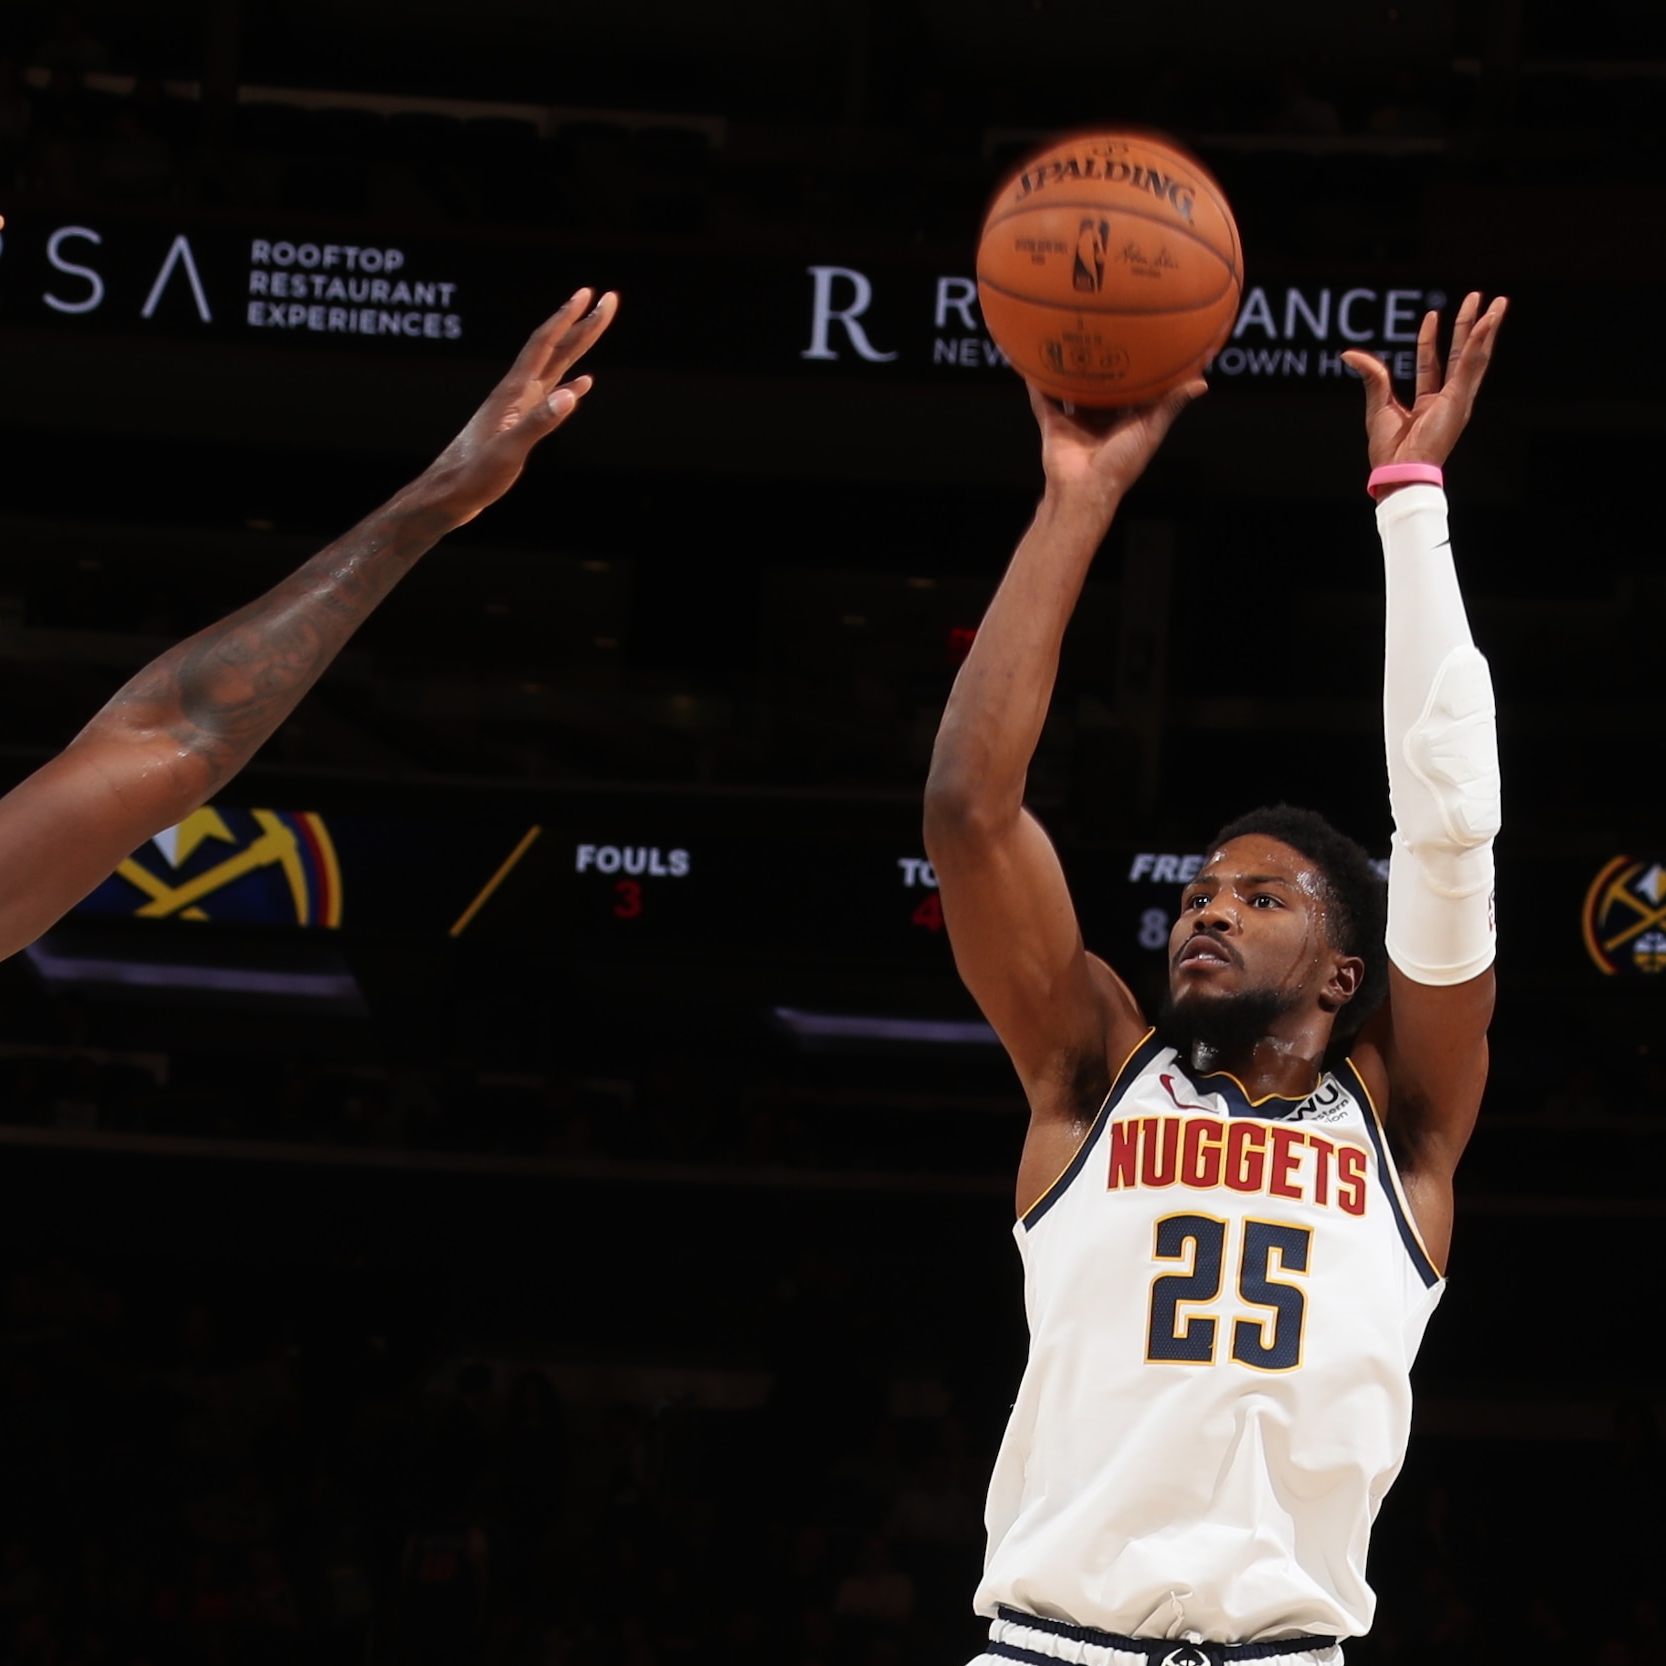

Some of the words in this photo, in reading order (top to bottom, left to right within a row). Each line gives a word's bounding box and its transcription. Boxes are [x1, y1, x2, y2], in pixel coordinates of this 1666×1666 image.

[1015, 157, 1197, 221] SPALDING
[251, 239, 405, 273] ROOFTOP
[249, 270, 457, 308] RESTAURANT
[247, 301, 462, 339] EXPERIENCES
[801, 265, 897, 363] R
[575, 844, 690, 877] FOULS
[897, 857, 939, 888] TO
[1129, 853, 1205, 883] FRE
[614, 880, 643, 919] 3
[1137, 909, 1171, 950] 8
[1106, 1116, 1369, 1219] NUGGETS
[1143, 1210, 1315, 1374] 25
